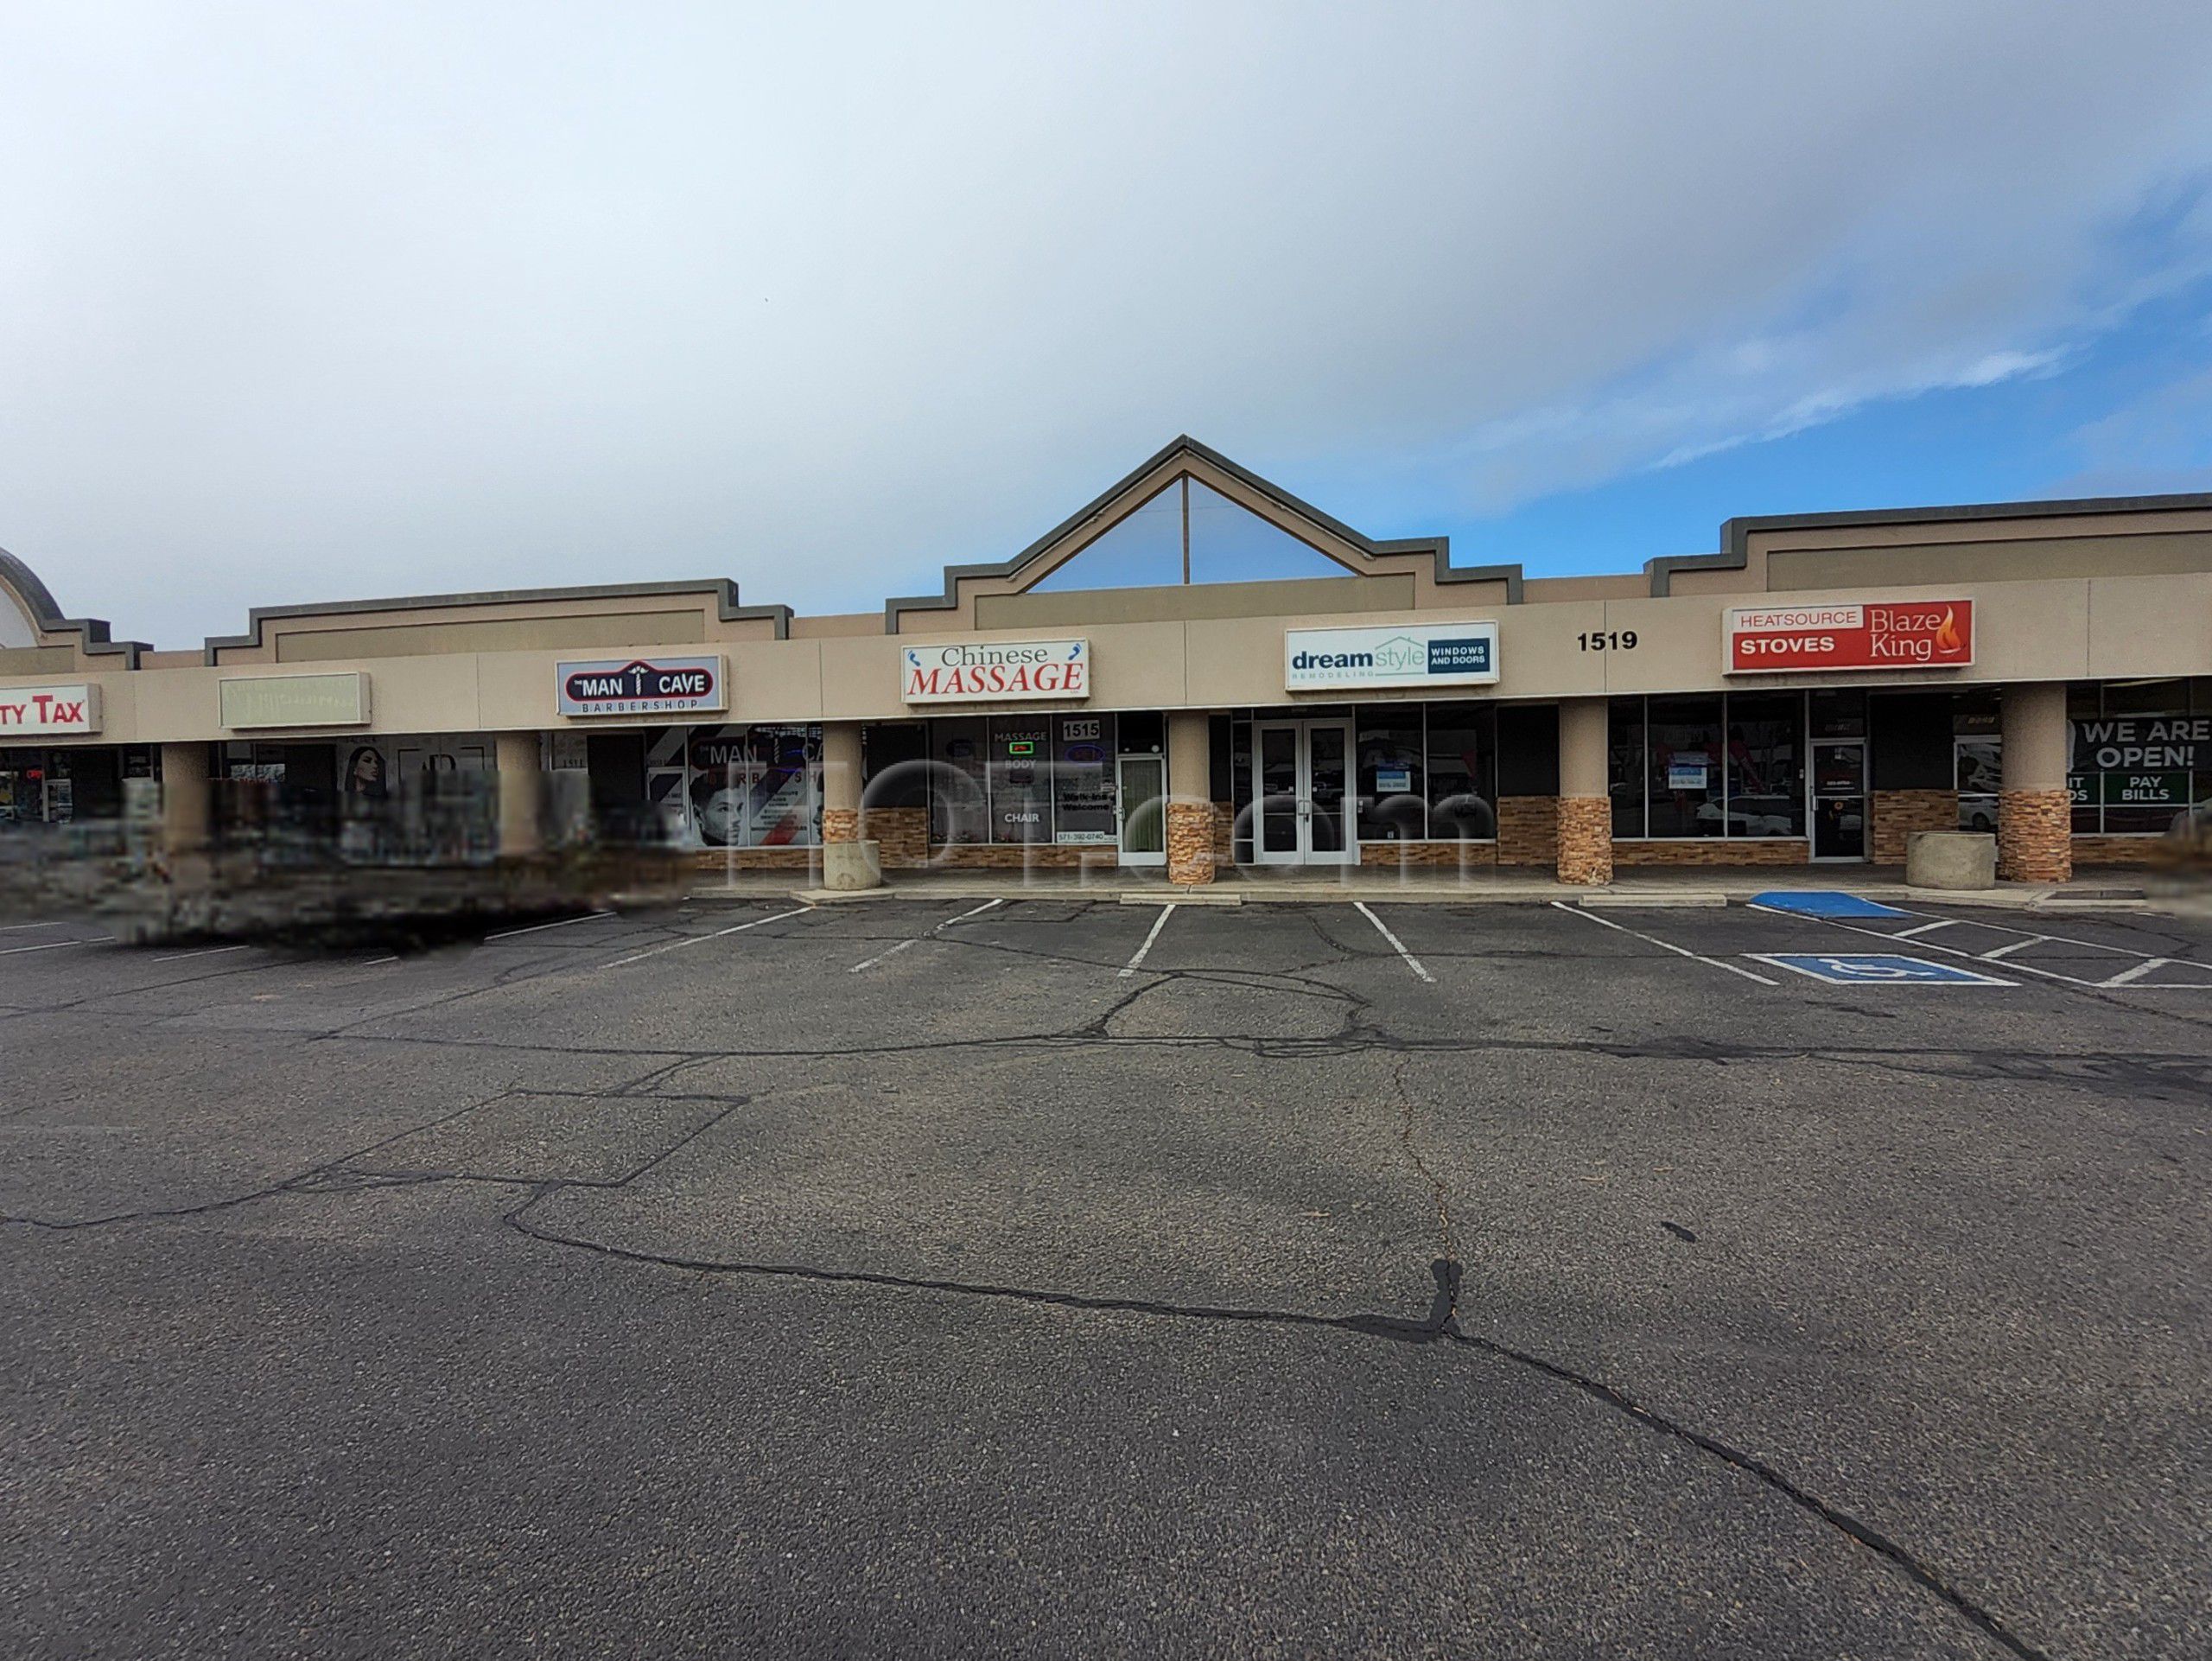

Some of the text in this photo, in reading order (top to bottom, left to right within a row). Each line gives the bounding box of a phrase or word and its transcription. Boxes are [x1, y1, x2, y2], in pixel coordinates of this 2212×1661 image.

[1740, 610, 1857, 628] HEATSOURCE
[1869, 608, 1942, 633] Blaze
[1577, 631, 1638, 652] 1519
[1740, 635, 1835, 656] STOVES
[1869, 632, 1932, 662] King
[941, 646, 1048, 667] Chinese
[1431, 646, 1484, 657] WINDOWS
[1453, 654, 1485, 665] DOORS
[907, 663, 1084, 696] MASSAGE
[1292, 670, 1375, 679] REMODELING
[582, 678, 622, 697] MAN
[659, 673, 705, 695] CAVE
[582, 699, 698, 713] BARBERSHOP
[995, 731, 1047, 741] MASSAGE
[1064, 723, 1099, 736] 1515
[2082, 719, 2212, 743] WE ARE
[709, 745, 758, 764] MAN
[2096, 746, 2196, 767] OPEN!
[1005, 760, 1037, 769] BODY
[2130, 776, 2162, 787] PAY
[2121, 789, 2171, 800] BILLS
[1004, 813, 1039, 822] CHAIR
